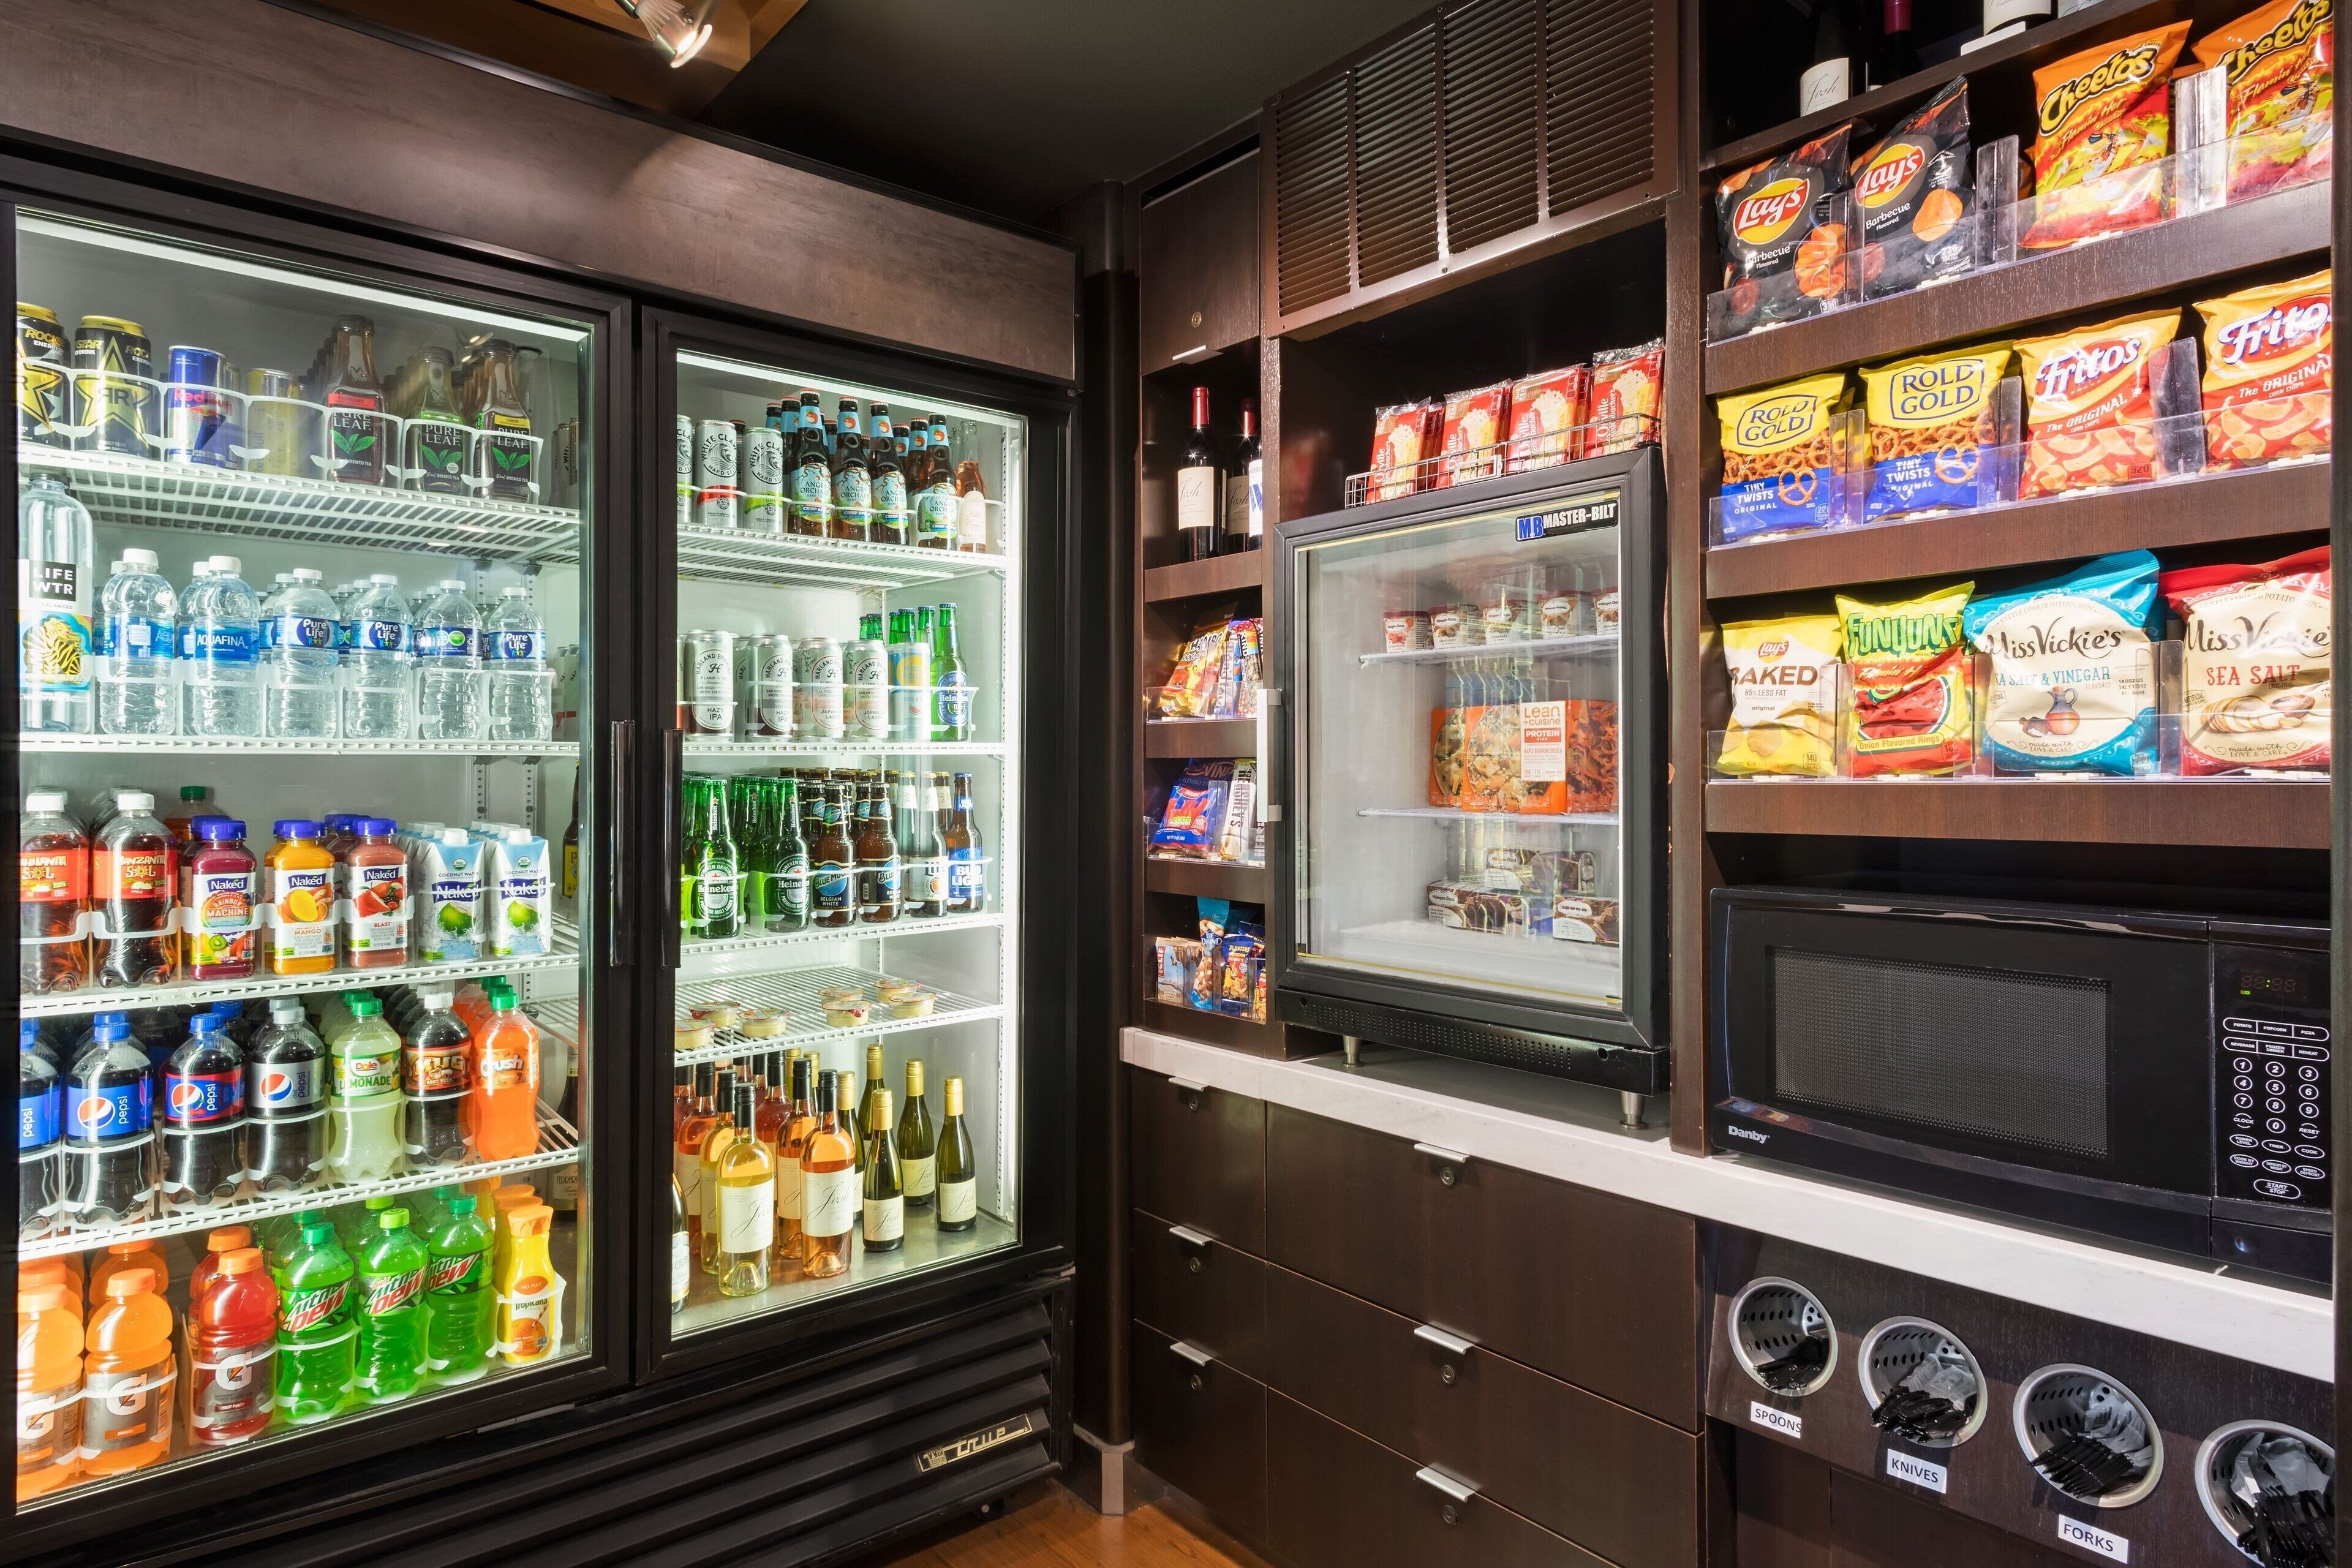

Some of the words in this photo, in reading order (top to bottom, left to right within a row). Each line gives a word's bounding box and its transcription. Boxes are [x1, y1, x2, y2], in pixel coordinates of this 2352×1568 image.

[2040, 48, 2157, 135] Cheetos
[1861, 148, 1923, 197] Lay's
[1738, 186, 1801, 231] Lay's
[1866, 202, 1910, 231] Barbecue
[1876, 216, 1899, 230] Flavored
[1756, 258, 1779, 269] Flavored
[2218, 303, 2331, 364] Frito
[2036, 339, 2141, 401] Fritos
[1902, 364, 1973, 393] ROLD
[174, 388, 205, 403] Red
[2239, 387, 2258, 398] The
[2269, 389, 2285, 398] CORN
[2286, 383, 2304, 393] CHIPS
[1901, 386, 1973, 413] GOLD
[1751, 401, 1808, 423] ROLD
[2047, 422, 2063, 432] The
[2067, 393, 2127, 427] ORIGINAL
[334, 418, 370, 431] LEAF
[426, 425, 460, 437] PURE
[1746, 417, 1803, 440] GOLD
[426, 434, 460, 446] LEAF
[498, 437, 527, 448] LEAF
[701, 435, 716, 461] WHITE
[750, 443, 764, 468] WHITE
[709, 465, 724, 475] HARD
[1896, 459, 1920, 470] TINY
[2130, 464, 2149, 474] 320
[757, 472, 772, 481] HARD
[1887, 469, 1931, 483] TWISTS
[1744, 483, 1765, 492] TINY
[1738, 491, 1774, 503] TWISTS
[1544, 503, 1616, 527] MASTER-BILT
[1735, 503, 1777, 514] ORIGINAL
[34, 569, 74, 581] LIFE
[33, 582, 74, 595] WTR
[303, 619, 326, 631] Pure
[375, 621, 399, 633] Pure
[306, 628, 324, 638] Life
[377, 630, 395, 641] Life
[506, 633, 528, 643] Pure
[1848, 613, 1962, 657] FUNYUNS
[2027, 616, 2122, 659] Vickie's
[2187, 620, 2242, 652] Miss
[197, 634, 245, 648] AQUAFINA
[509, 640, 526, 650] Life
[1760, 641, 1787, 656] Lay's
[696, 654, 715, 674] HARLAND
[2041, 673, 2050, 685] &
[2052, 666, 2111, 684] VINEGAR
[2206, 667, 2241, 685] SEA
[2250, 665, 2300, 684] SALT
[1525, 706, 1560, 718] Lean
[1860, 741, 1880, 750] Onion
[1882, 737, 1915, 748] Flavored
[1918, 734, 1940, 745] Rings
[367, 870, 396, 880] Naked
[958, 865, 981, 876] BUD
[211, 879, 244, 889] Naked
[292, 876, 323, 886] Naked
[815, 876, 830, 888] BLUE
[214, 898, 241, 907] RAINBOW
[207, 908, 248, 917] MACHINE
[416, 1056, 464, 1075] MUG
[299, 1072, 307, 1098] pepsi
[206, 1084, 217, 1111] pepsi
[119, 1096, 129, 1125] pepsi
[23, 1107, 34, 1137] pepsi
[1728, 1125, 1768, 1144] Danby
[516, 1298, 548, 1311] Tropicana
[1755, 1408, 1801, 1433] SPOONS
[1891, 1457, 1939, 1483] KNIVES
[2064, 1523, 2114, 1553] FORKS
